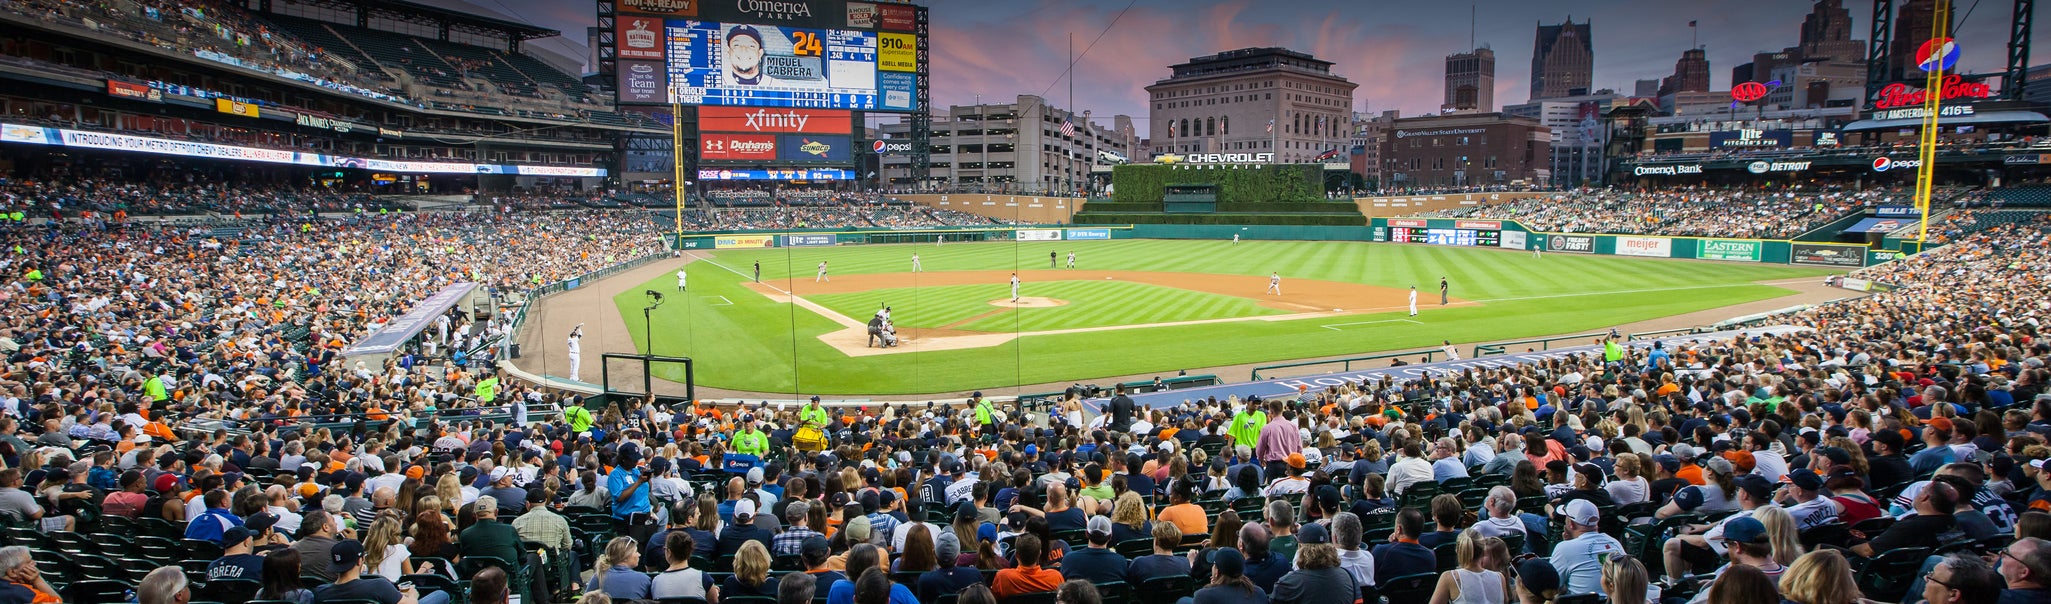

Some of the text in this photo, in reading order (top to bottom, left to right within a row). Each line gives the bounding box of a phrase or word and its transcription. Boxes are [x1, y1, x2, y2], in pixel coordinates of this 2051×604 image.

[758, 12, 793, 20] PARK
[792, 31, 823, 56] 24
[881, 37, 903, 49] 910
[882, 48, 914, 56] Superstation
[767, 57, 803, 67] MIGUEL
[767, 66, 812, 77] CABRERA
[629, 77, 656, 88] Team
[679, 87, 707, 95] ORIOLES
[680, 95, 703, 103] TIGERS
[866, 95, 873, 104] 2
[1873, 111, 1887, 120] NEW
[1941, 106, 1961, 116] 416
[296, 112, 309, 126] JACK
[745, 109, 809, 131] xfinity
[1740, 128, 1763, 141] Lite
[69, 132, 123, 147] INTRODUCING
[124, 137, 144, 149] YOUR
[145, 139, 168, 151] METRO
[170, 142, 196, 154] DETROIT
[197, 144, 217, 156] CHEVY
[217, 146, 242, 158] DEALERS
[730, 140, 774, 152] Dunham's
[886, 142, 912, 152] pepsi
[1188, 152, 1275, 163] CHEVROLET
[1677, 163, 1703, 174] Bank
[1770, 161, 1812, 172] DETROIT
[789, 235, 804, 246] Lite
[1088, 231, 1107, 239] Energy
[1626, 237, 1660, 250] meijer
[1704, 240, 1754, 251] EASTERN
[207, 564, 244, 580] ABRERA
